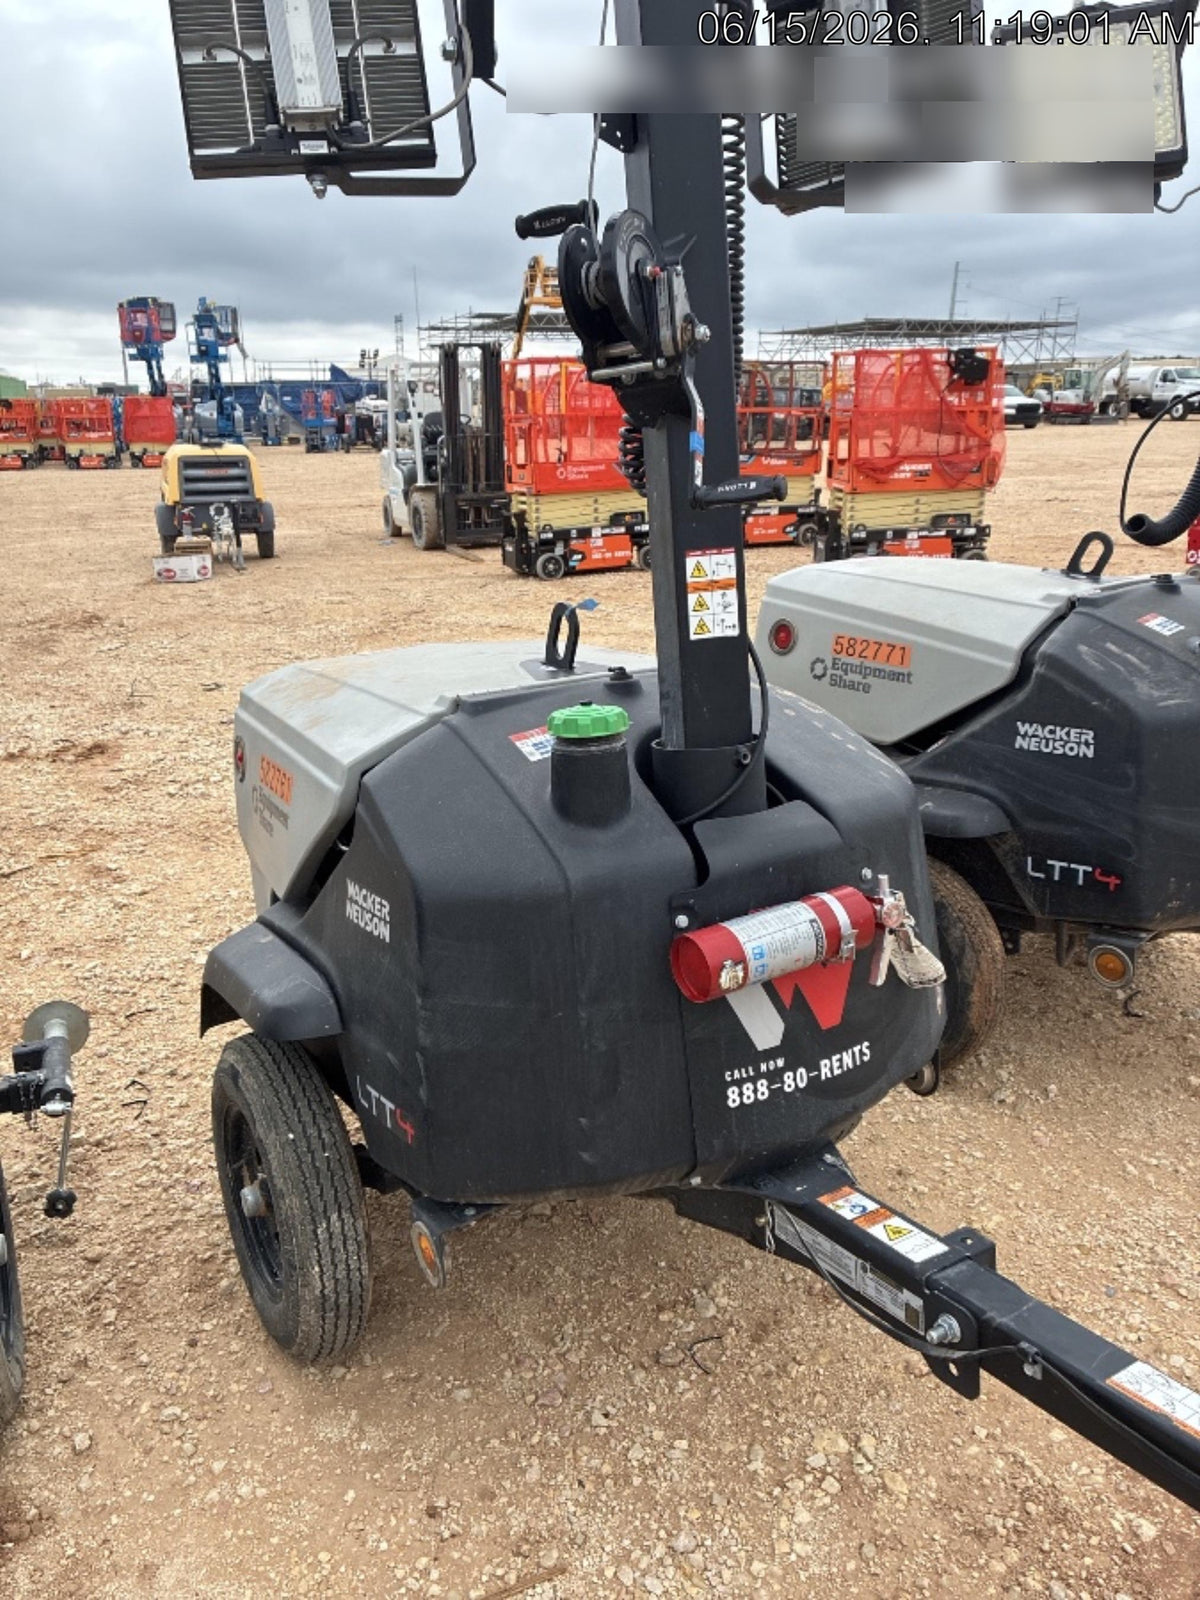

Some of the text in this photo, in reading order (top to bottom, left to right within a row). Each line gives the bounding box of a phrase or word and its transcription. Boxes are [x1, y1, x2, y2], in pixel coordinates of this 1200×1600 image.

[832, 635, 907, 666] 582771
[829, 673, 872, 694] Share
[831, 657, 914, 685] Equipment
[1015, 735, 1095, 758] NEUSON
[1016, 721, 1095, 744] WACKER
[1026, 856, 1122, 893] LTT4
[345, 878, 391, 922] WACKER
[345, 898, 390, 943] NEUSON
[724, 1057, 785, 1082] CALL NOW
[726, 1041, 871, 1108] 888-80-RENTS
[356, 1075, 415, 1146] LTT4
